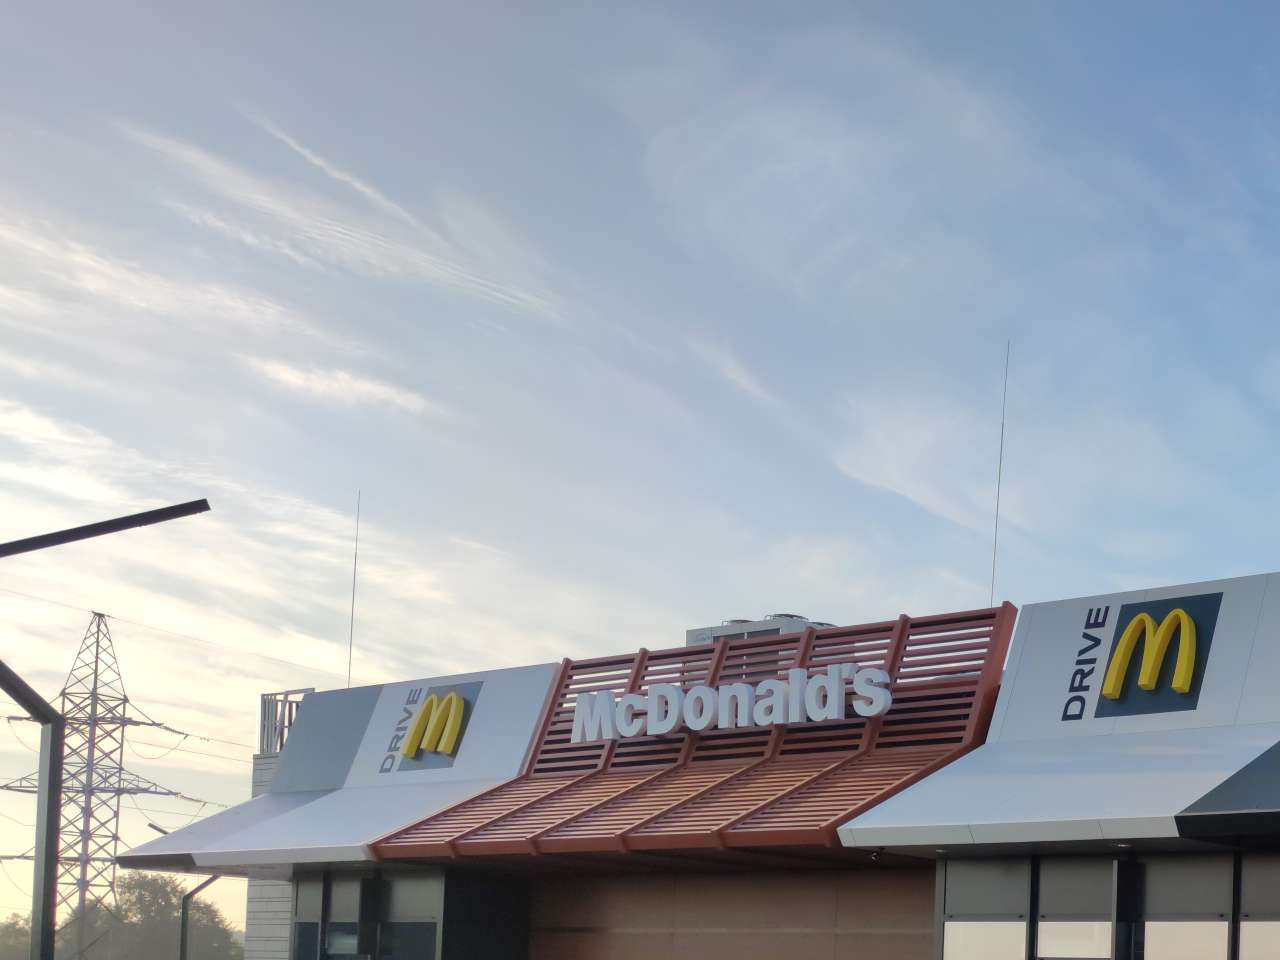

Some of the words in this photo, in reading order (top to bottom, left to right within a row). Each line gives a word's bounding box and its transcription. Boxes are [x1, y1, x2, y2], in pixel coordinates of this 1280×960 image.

[570, 662, 893, 744] McDonald's
[1060, 605, 1110, 722] DRIVE
[379, 688, 423, 774] DRIVE
